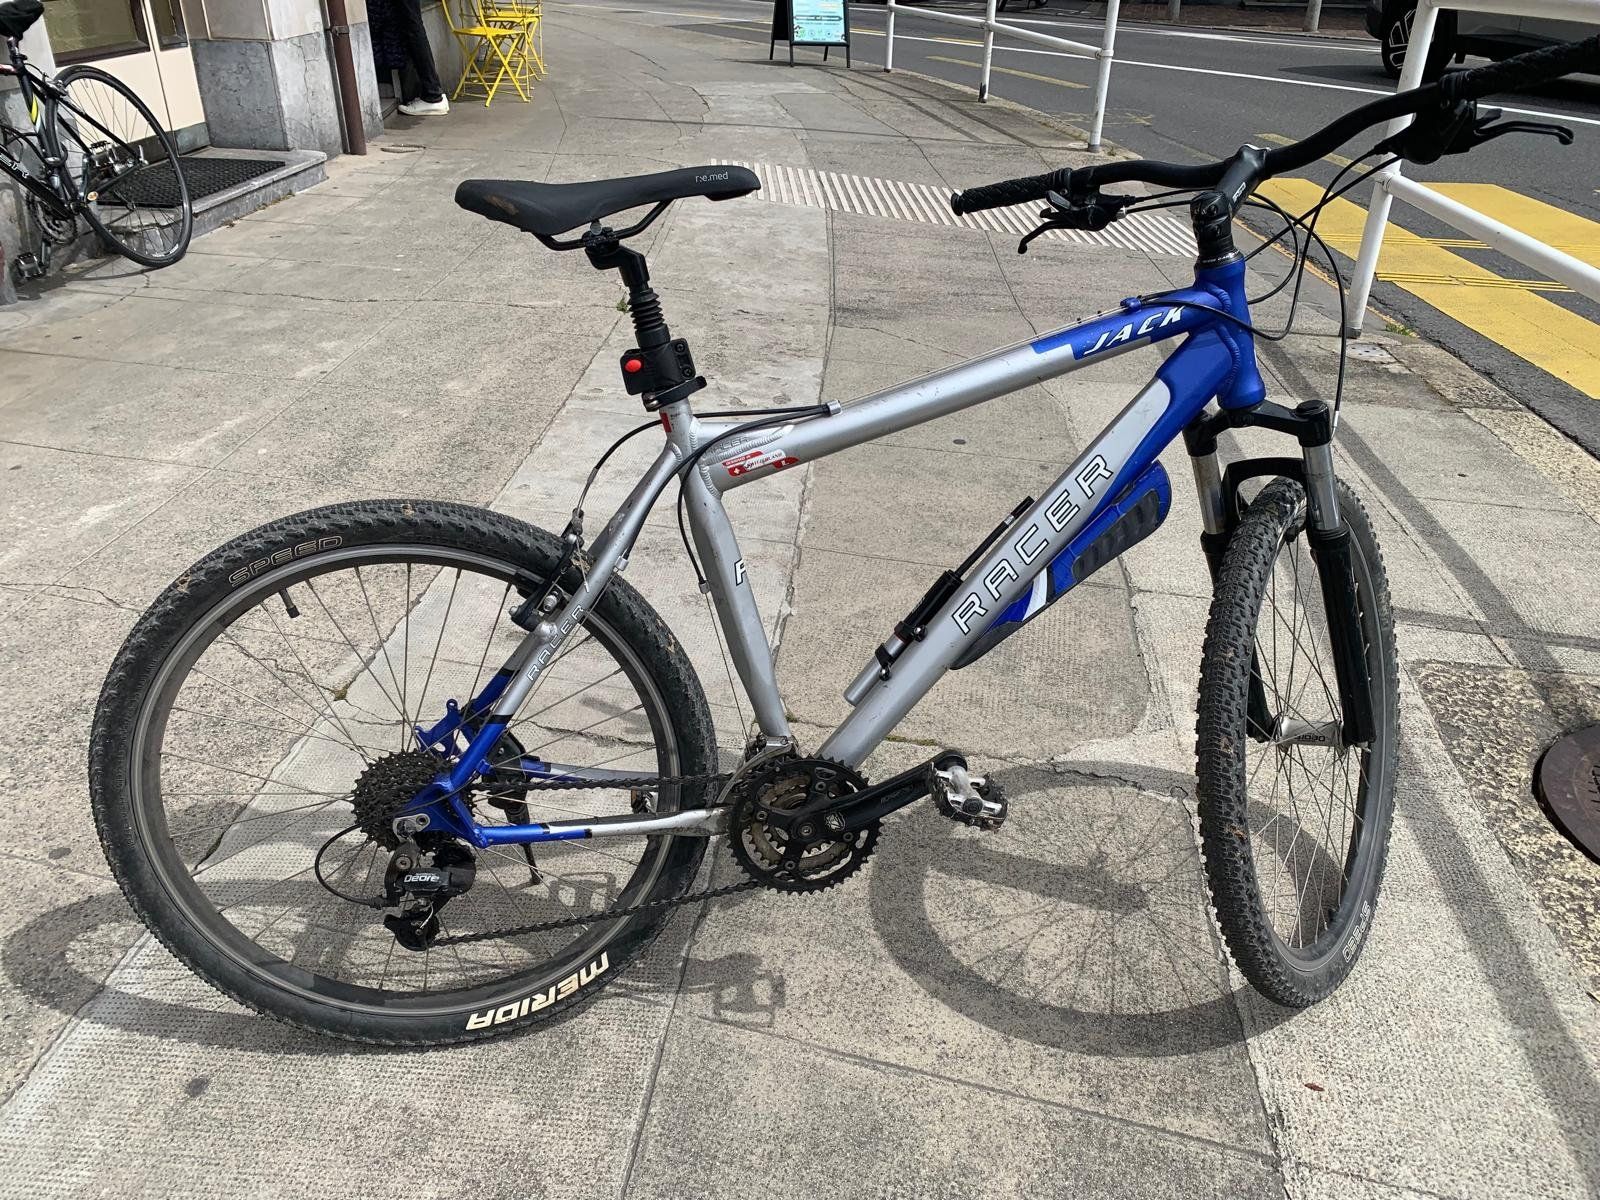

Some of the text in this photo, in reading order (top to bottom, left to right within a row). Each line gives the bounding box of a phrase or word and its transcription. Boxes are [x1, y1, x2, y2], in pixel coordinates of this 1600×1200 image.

[1083, 305, 1186, 355] JACK
[228, 535, 343, 588] SPEED
[951, 454, 1114, 636] RACER
[526, 604, 584, 681] RACER
[465, 951, 610, 1031] MERIDA
